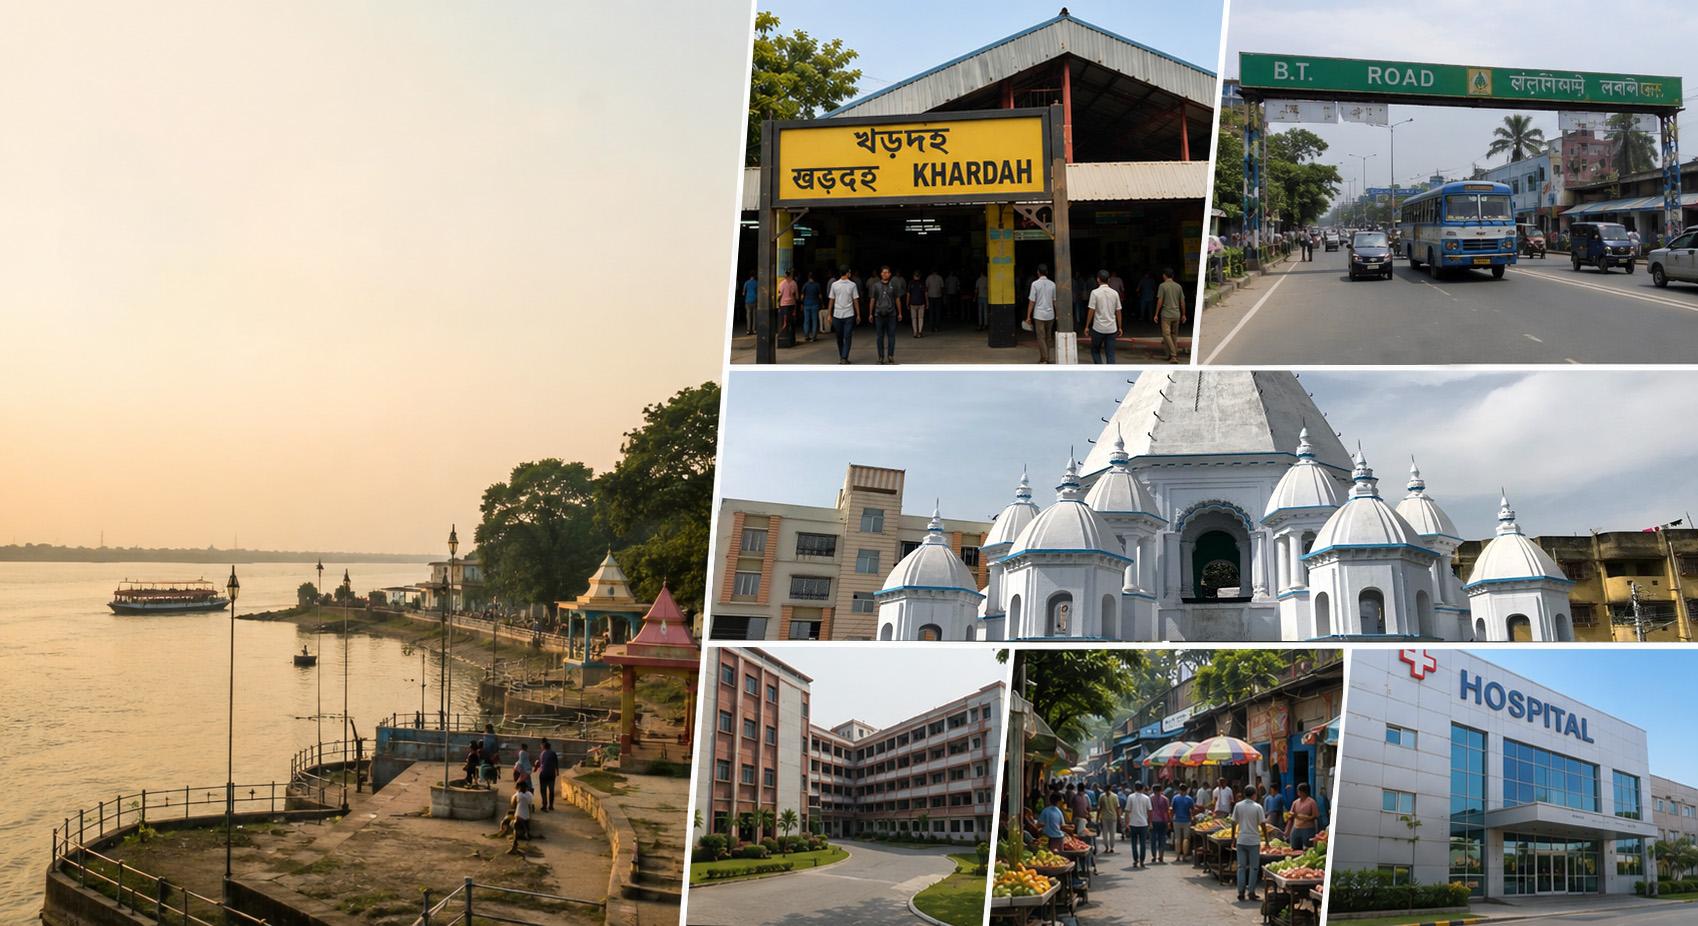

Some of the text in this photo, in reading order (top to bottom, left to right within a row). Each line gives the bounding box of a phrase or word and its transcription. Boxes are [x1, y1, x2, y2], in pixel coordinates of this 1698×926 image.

[1273, 61, 1435, 87] B.T. ROAD
[854, 127, 950, 159] খড়দহ
[912, 159, 1033, 187] KHARDAH
[1460, 669, 1595, 744] HOSPITAL
